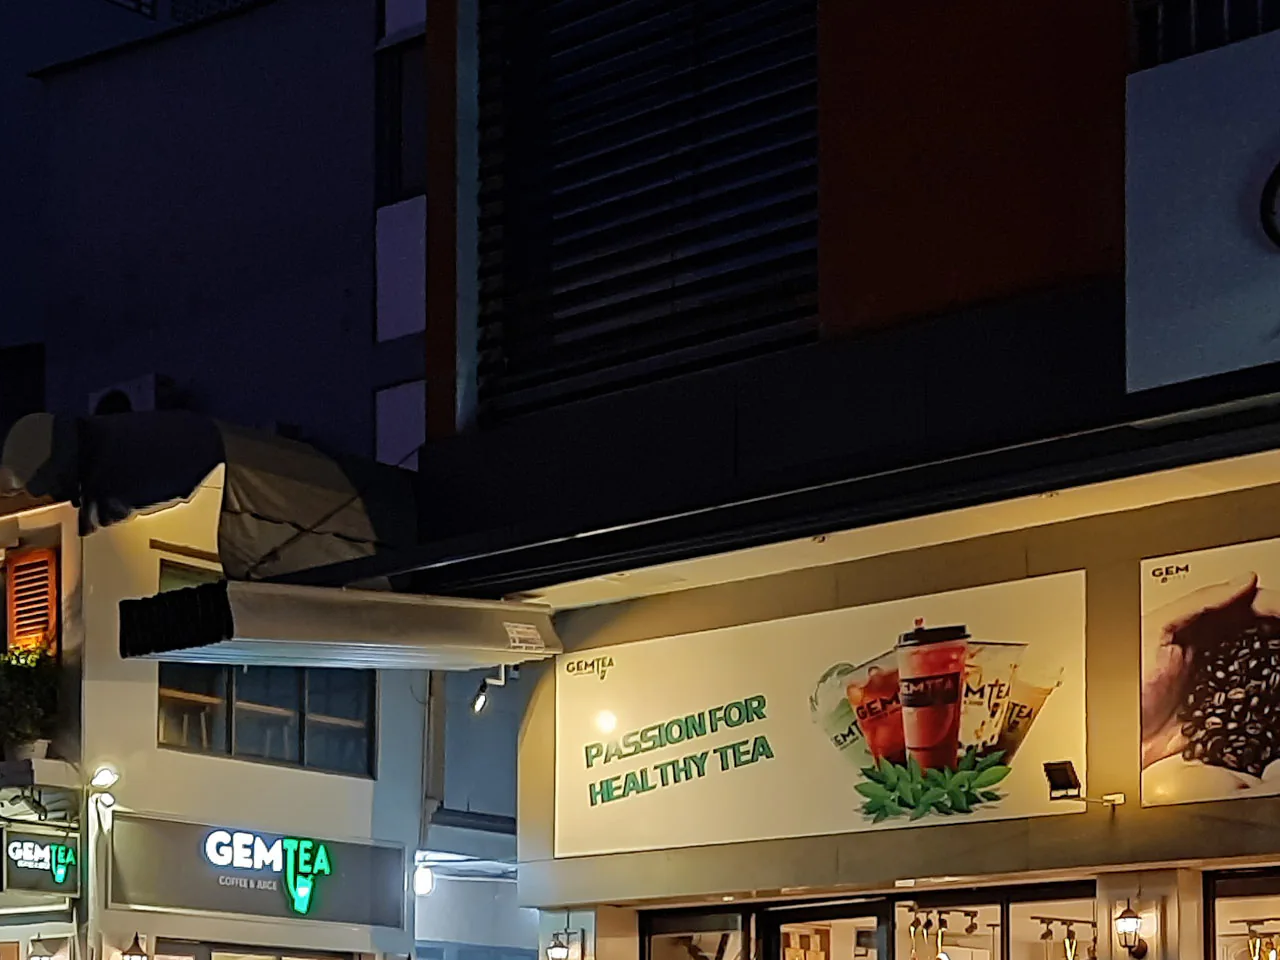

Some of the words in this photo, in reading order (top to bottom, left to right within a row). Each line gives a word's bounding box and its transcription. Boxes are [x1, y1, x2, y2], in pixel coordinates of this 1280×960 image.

[1151, 564, 1189, 577] GEM
[585, 712, 707, 768] PASSION
[708, 695, 767, 733] FOR
[589, 752, 709, 806] HEALTHY
[713, 735, 775, 772] TEA
